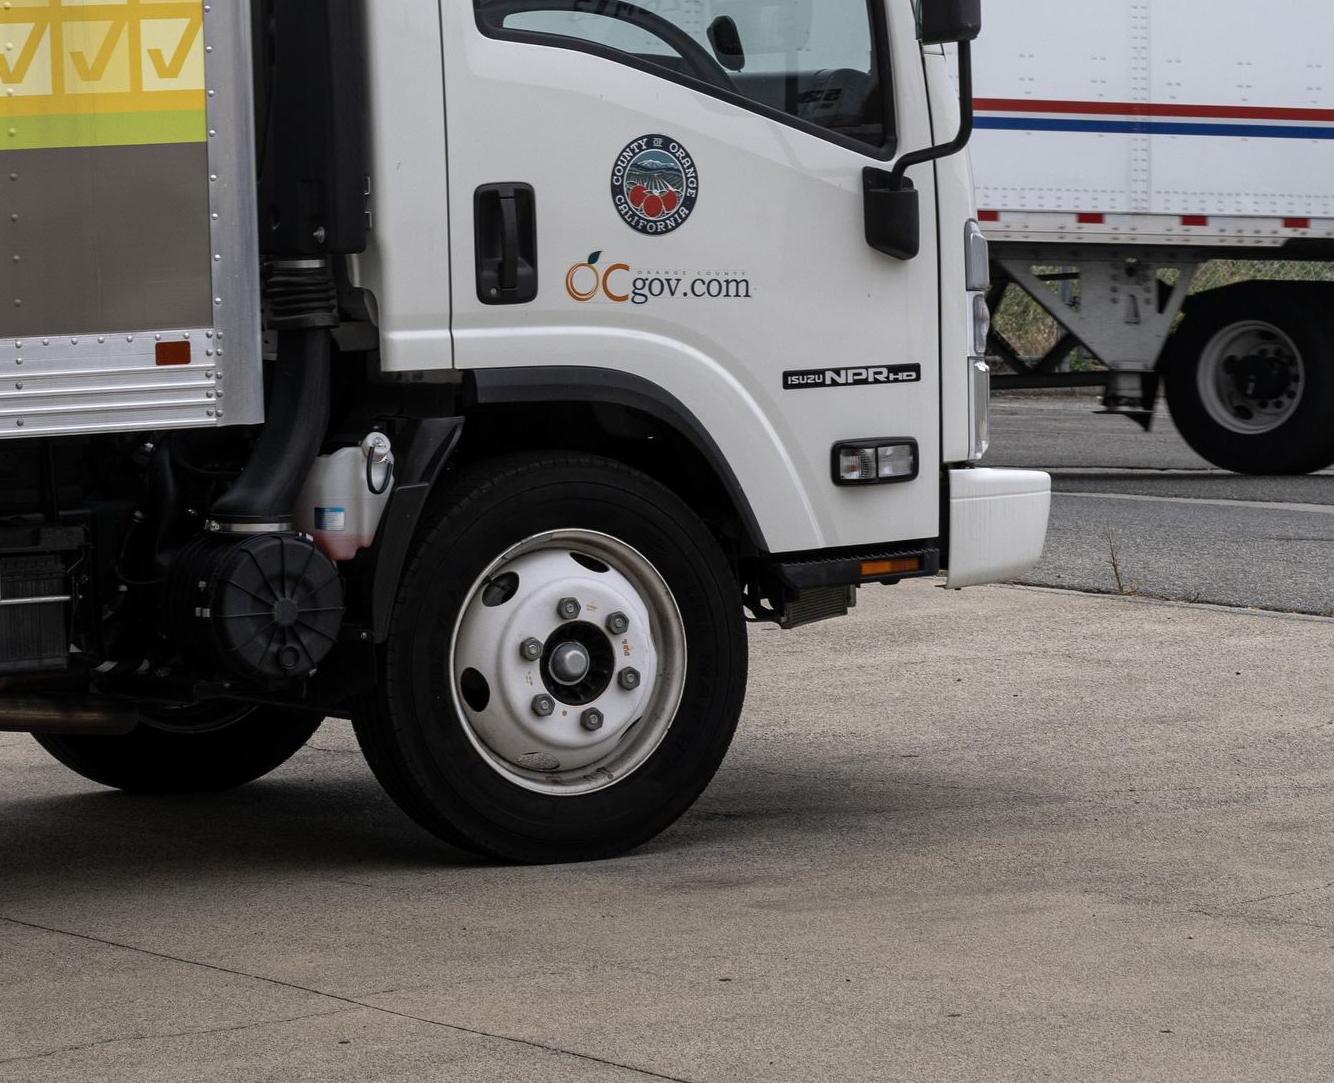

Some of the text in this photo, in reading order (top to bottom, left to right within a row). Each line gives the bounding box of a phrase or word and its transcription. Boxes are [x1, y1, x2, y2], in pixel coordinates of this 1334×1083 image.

[612, 138, 697, 198] COUNTY OF ORANGE
[615, 194, 689, 233] CALIFORNIA
[788, 367, 917, 385] ISUZU NPR HD
